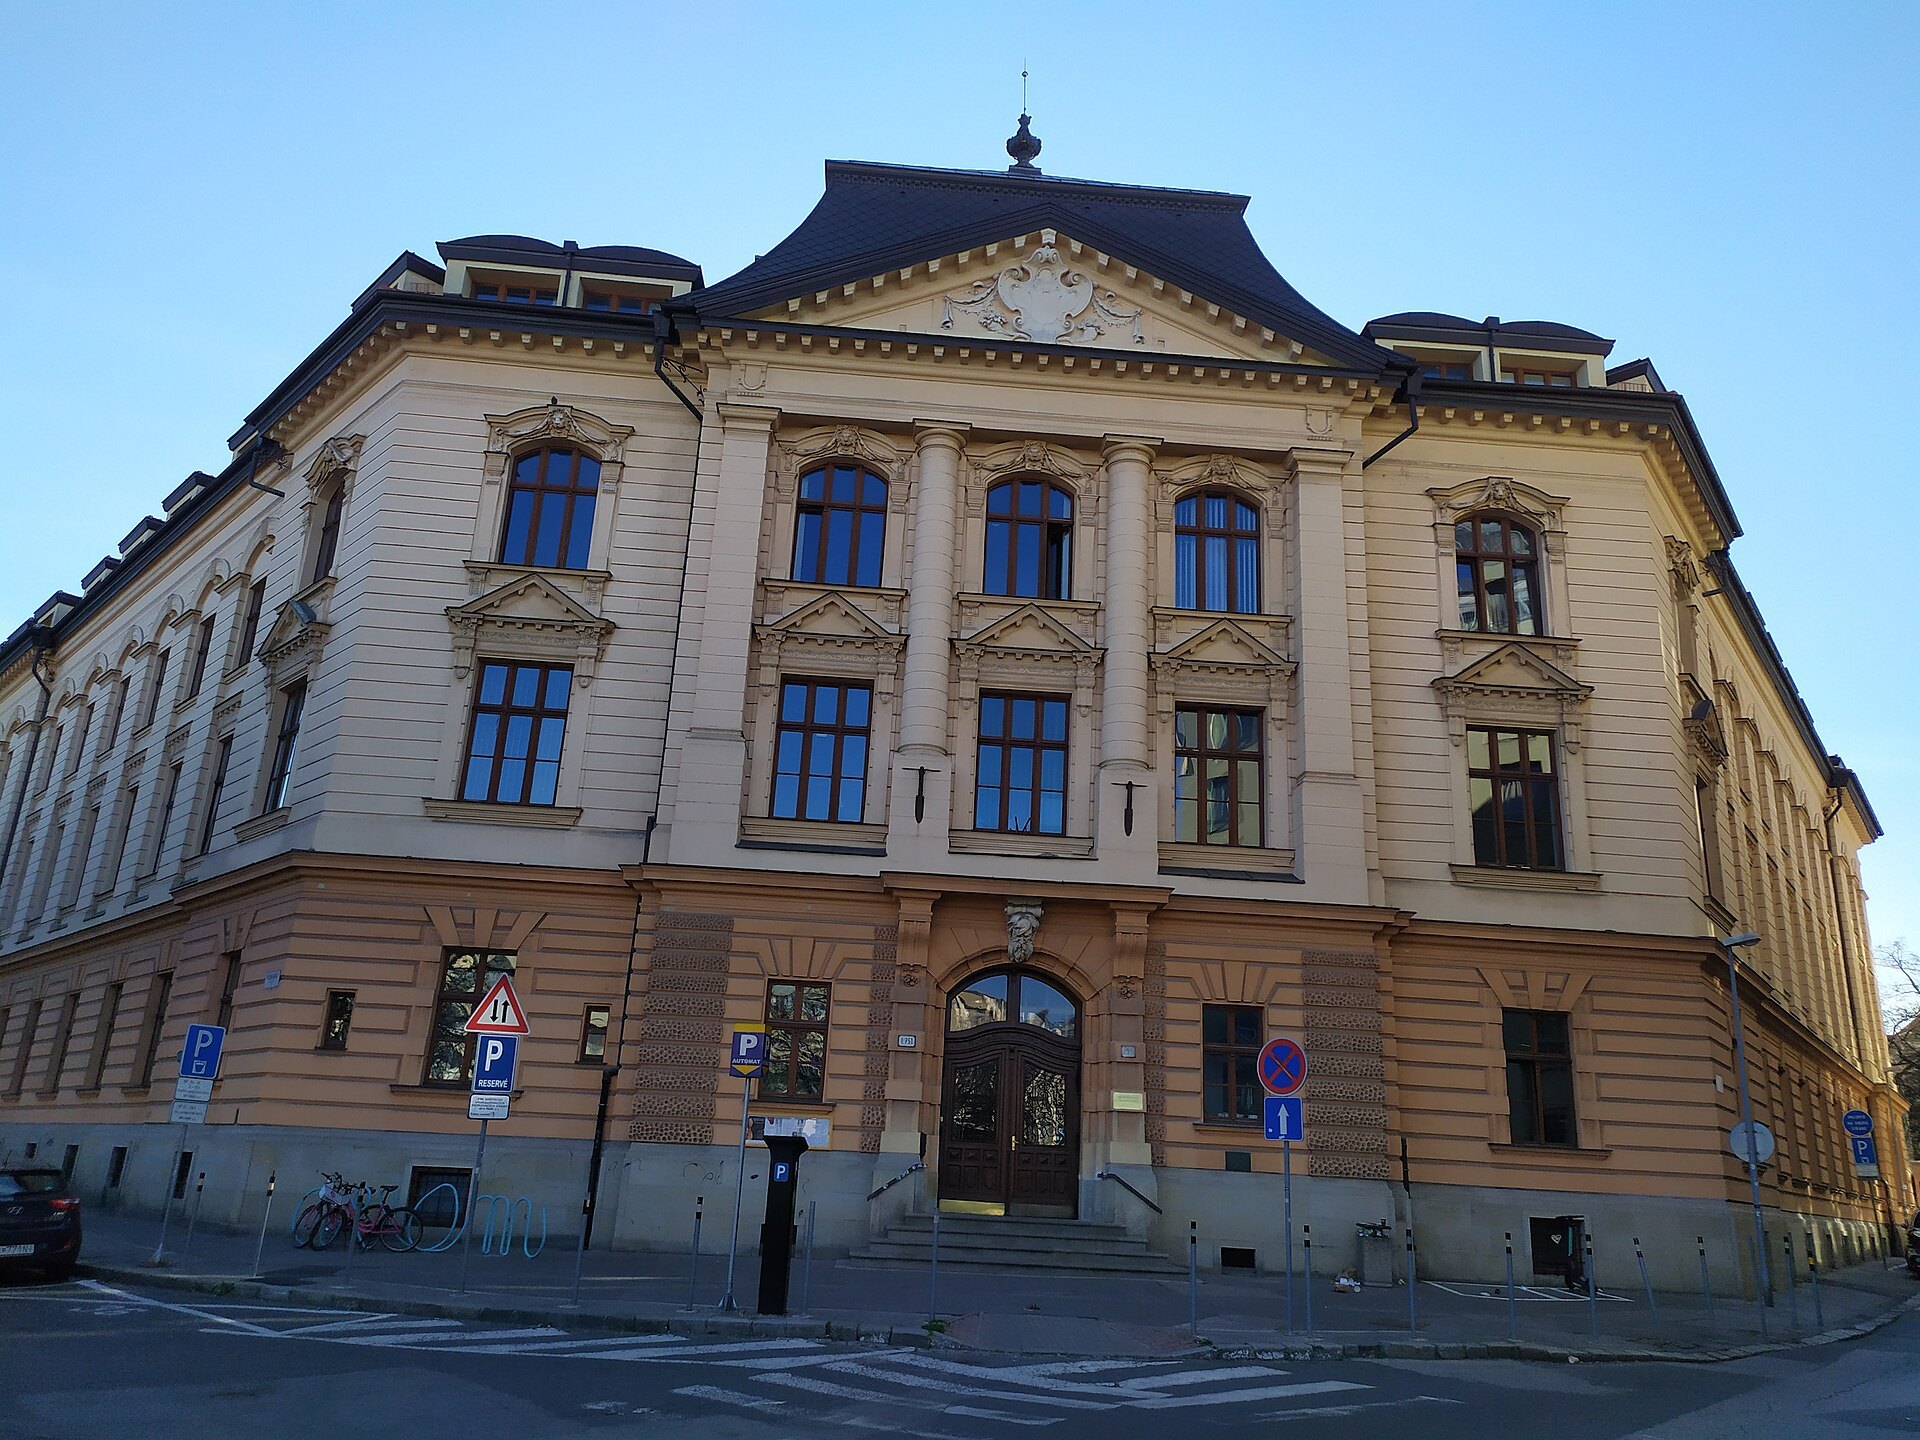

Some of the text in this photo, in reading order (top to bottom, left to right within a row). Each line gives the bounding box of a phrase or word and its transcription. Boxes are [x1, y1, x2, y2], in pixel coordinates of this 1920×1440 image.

[194, 1029, 214, 1057] P
[739, 1034, 758, 1056] P
[484, 1039, 503, 1071] P
[478, 1078, 508, 1088] RESERVÉ
[1857, 1140, 1868, 1155] P
[776, 1165, 786, 1179] P
